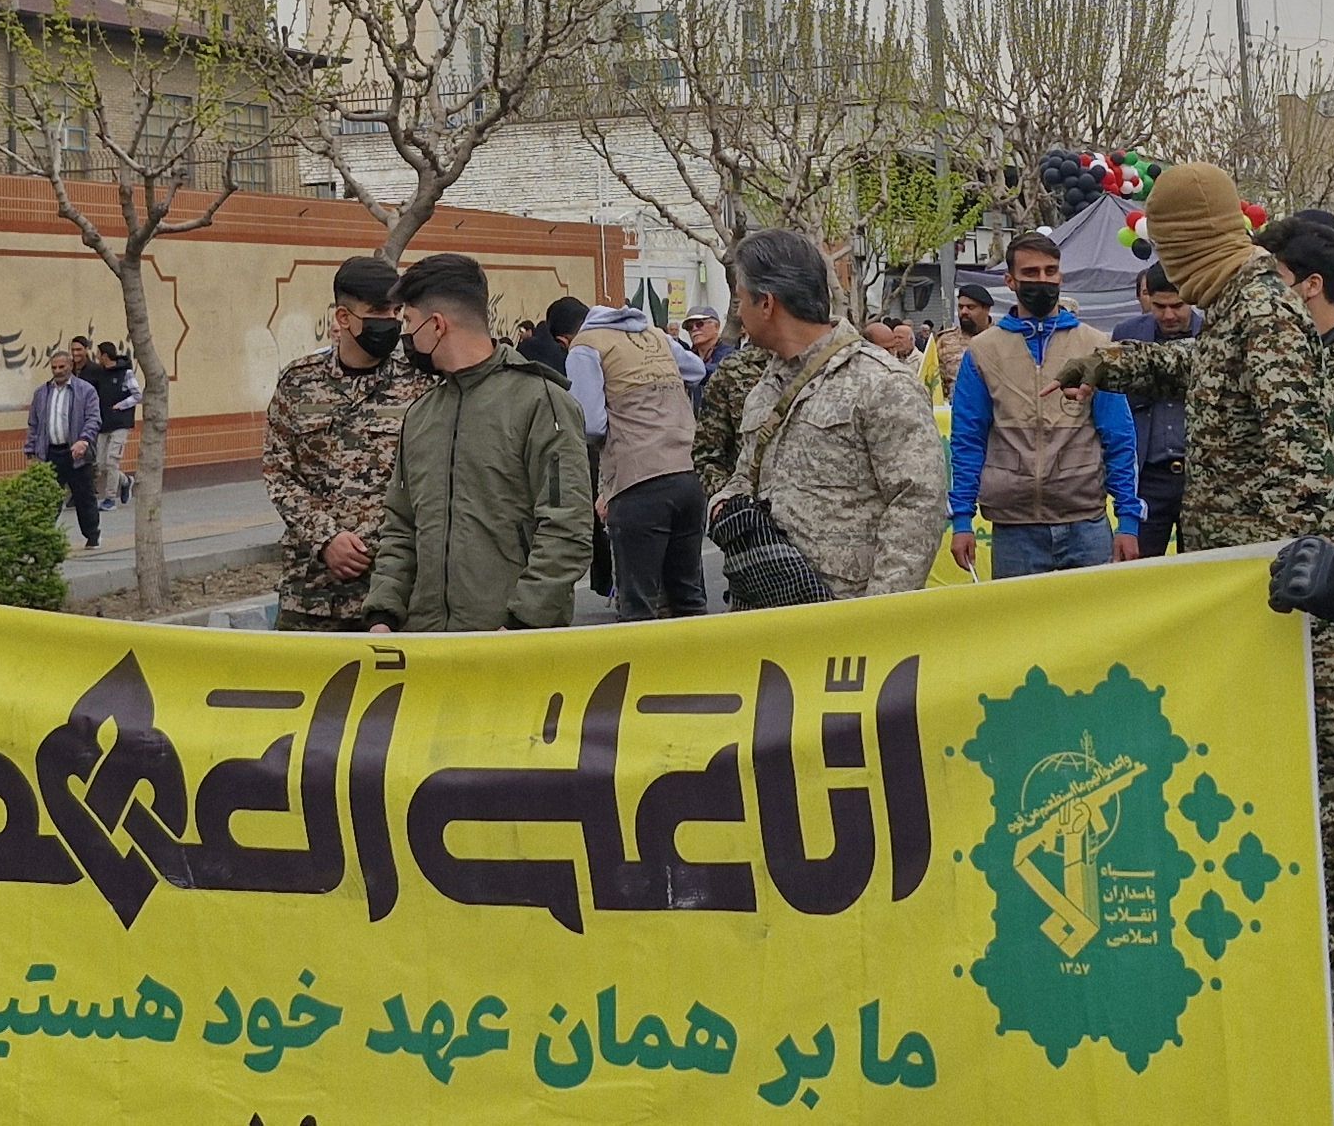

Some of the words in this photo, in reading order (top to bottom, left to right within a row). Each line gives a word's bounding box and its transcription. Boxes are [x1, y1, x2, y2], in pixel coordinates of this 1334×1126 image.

[1103, 886, 1155, 903] پاسداران
[1104, 907, 1157, 923] انقلاب
[1060, 962, 1090, 975] ۱۳۵۷
[1106, 931, 1158, 947] اسلامی
[202, 968, 343, 1073] خود
[366, 992, 510, 1085] عهد
[534, 984, 738, 1089] همان
[859, 998, 937, 1088] ما
[757, 1022, 835, 1110] بر
